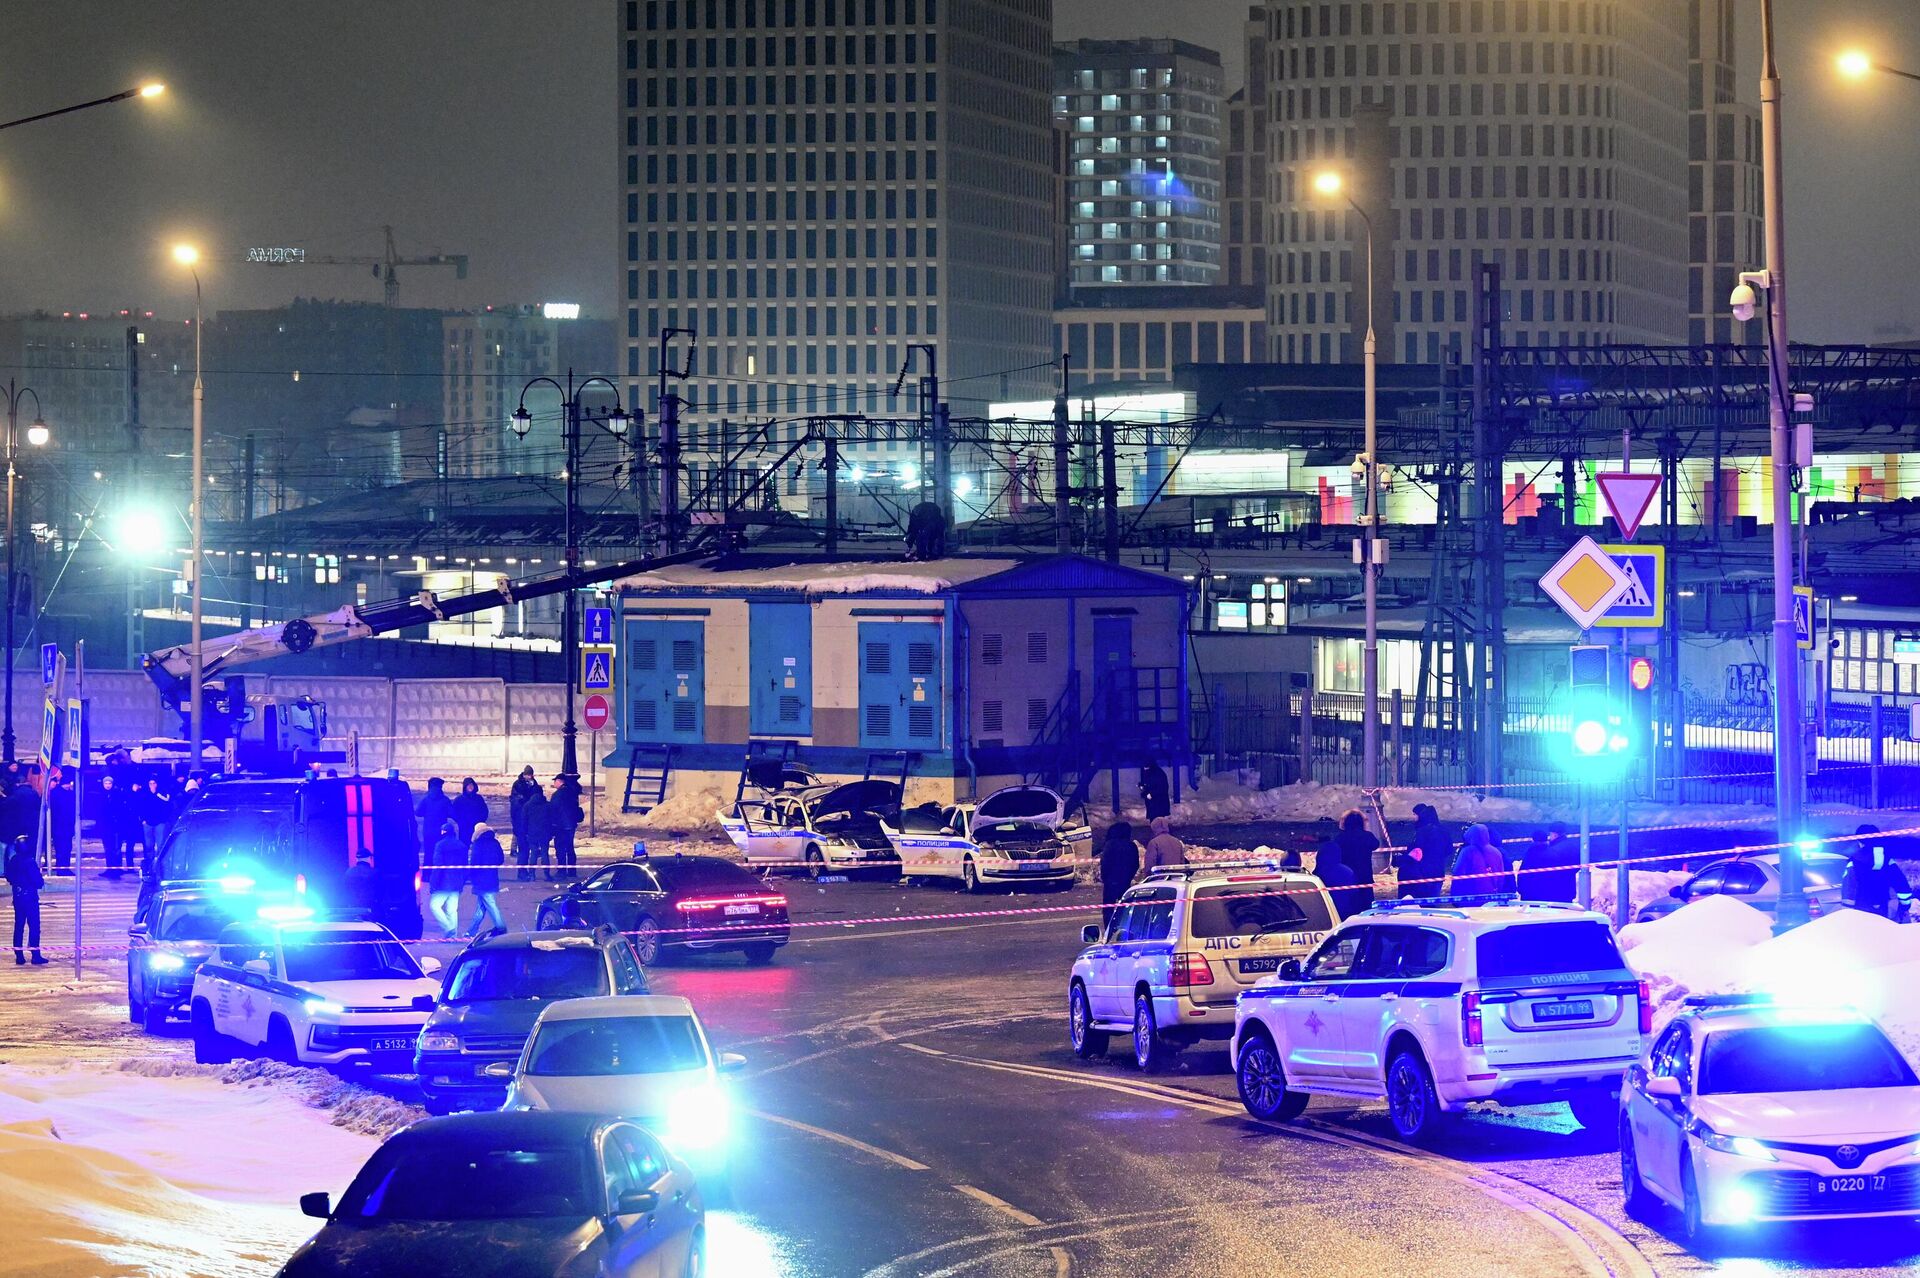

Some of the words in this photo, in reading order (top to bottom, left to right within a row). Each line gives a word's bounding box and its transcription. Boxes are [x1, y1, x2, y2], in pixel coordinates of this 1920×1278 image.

[1205, 937, 1242, 950] ДПС
[1290, 932, 1325, 946] ДПС
[1252, 960, 1276, 970] 5792
[1531, 973, 1590, 985] ПОЛИЦИЯ
[1549, 1004, 1575, 1016] 5771
[385, 1039, 406, 1049] 5132
[1831, 1177, 1865, 1191] 0220
[1873, 1176, 1886, 1188] 77
